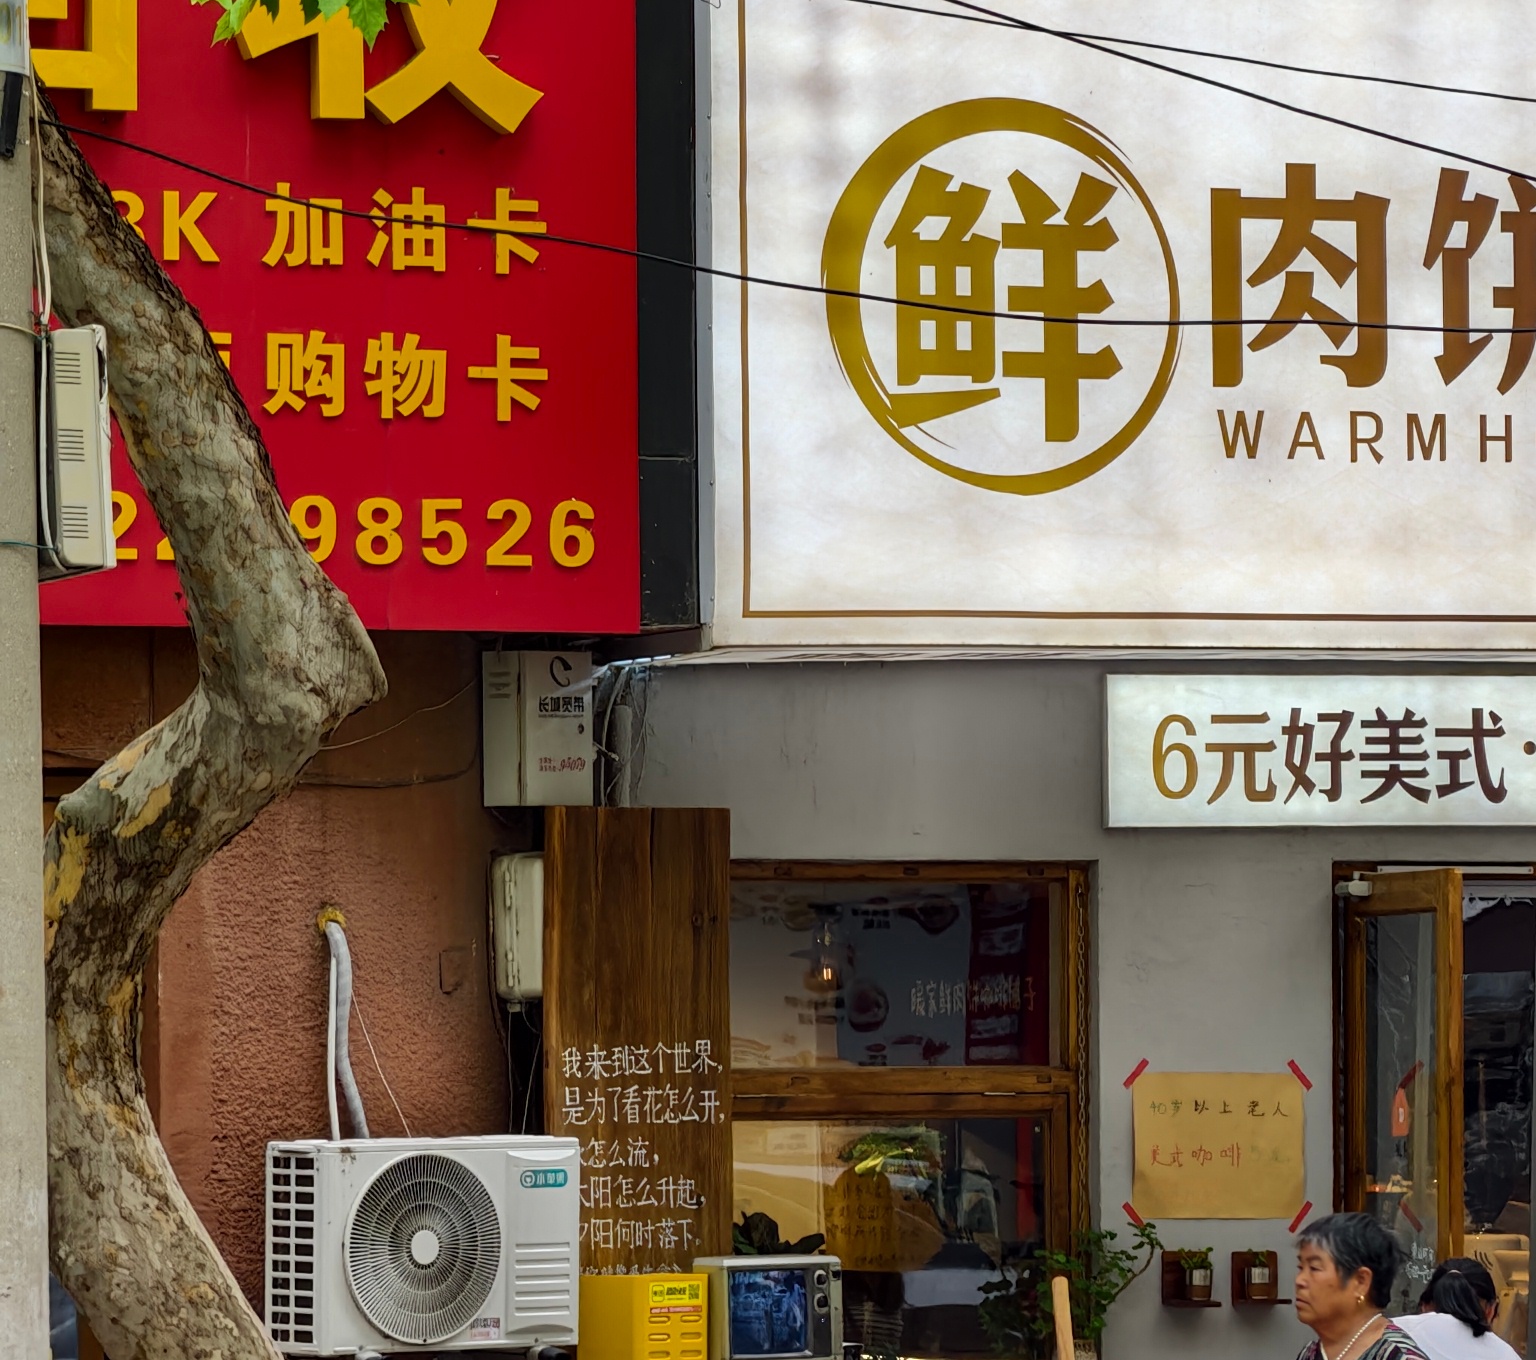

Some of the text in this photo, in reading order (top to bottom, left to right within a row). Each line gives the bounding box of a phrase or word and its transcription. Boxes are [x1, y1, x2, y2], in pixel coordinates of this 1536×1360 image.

[262, 182, 549, 275] 加油卡
[883, 164, 1123, 444] 鲜
[208, 329, 549, 422] 购物卡
[538, 696, 585, 713] 长城宽带
